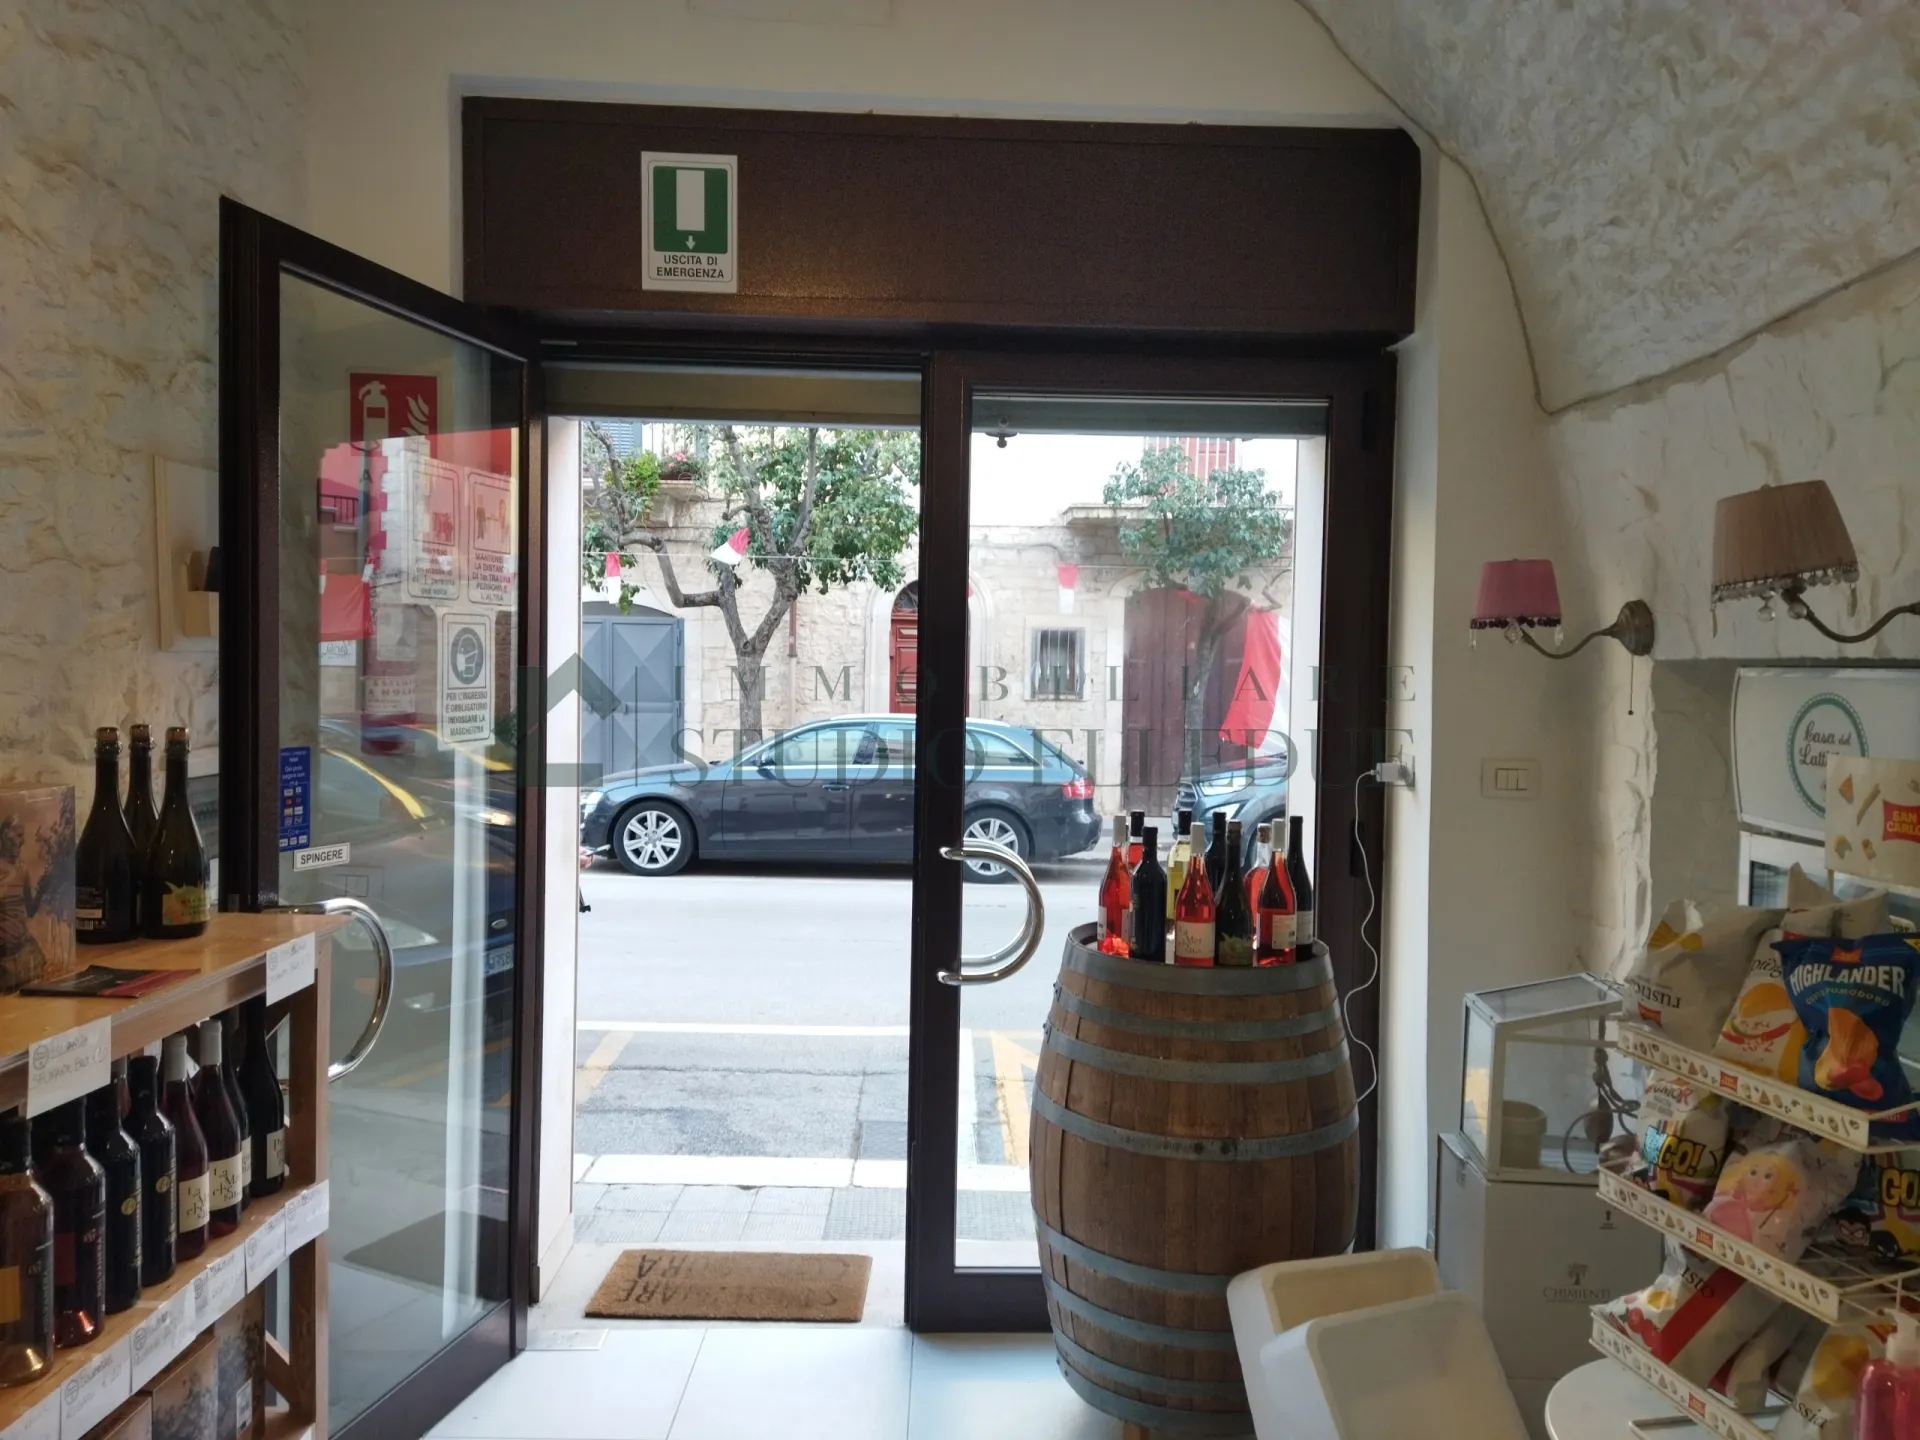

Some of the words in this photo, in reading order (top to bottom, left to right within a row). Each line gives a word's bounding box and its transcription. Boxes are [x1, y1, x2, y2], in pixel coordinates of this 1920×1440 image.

[663, 254, 703, 265] USCITA
[706, 255, 718, 266] DI
[656, 266, 725, 279] EMERGENZA
[445, 692, 457, 701] PER
[1803, 720, 1836, 745] Casa
[1893, 809, 1918, 823] SAN
[300, 848, 344, 866] SPINGERE
[1789, 963, 1906, 999] HIGHLANDER
[1825, 987, 1891, 1007] POMODORO
[1657, 1135, 1707, 1177] GO!
[1881, 1166, 1920, 1209] GO
